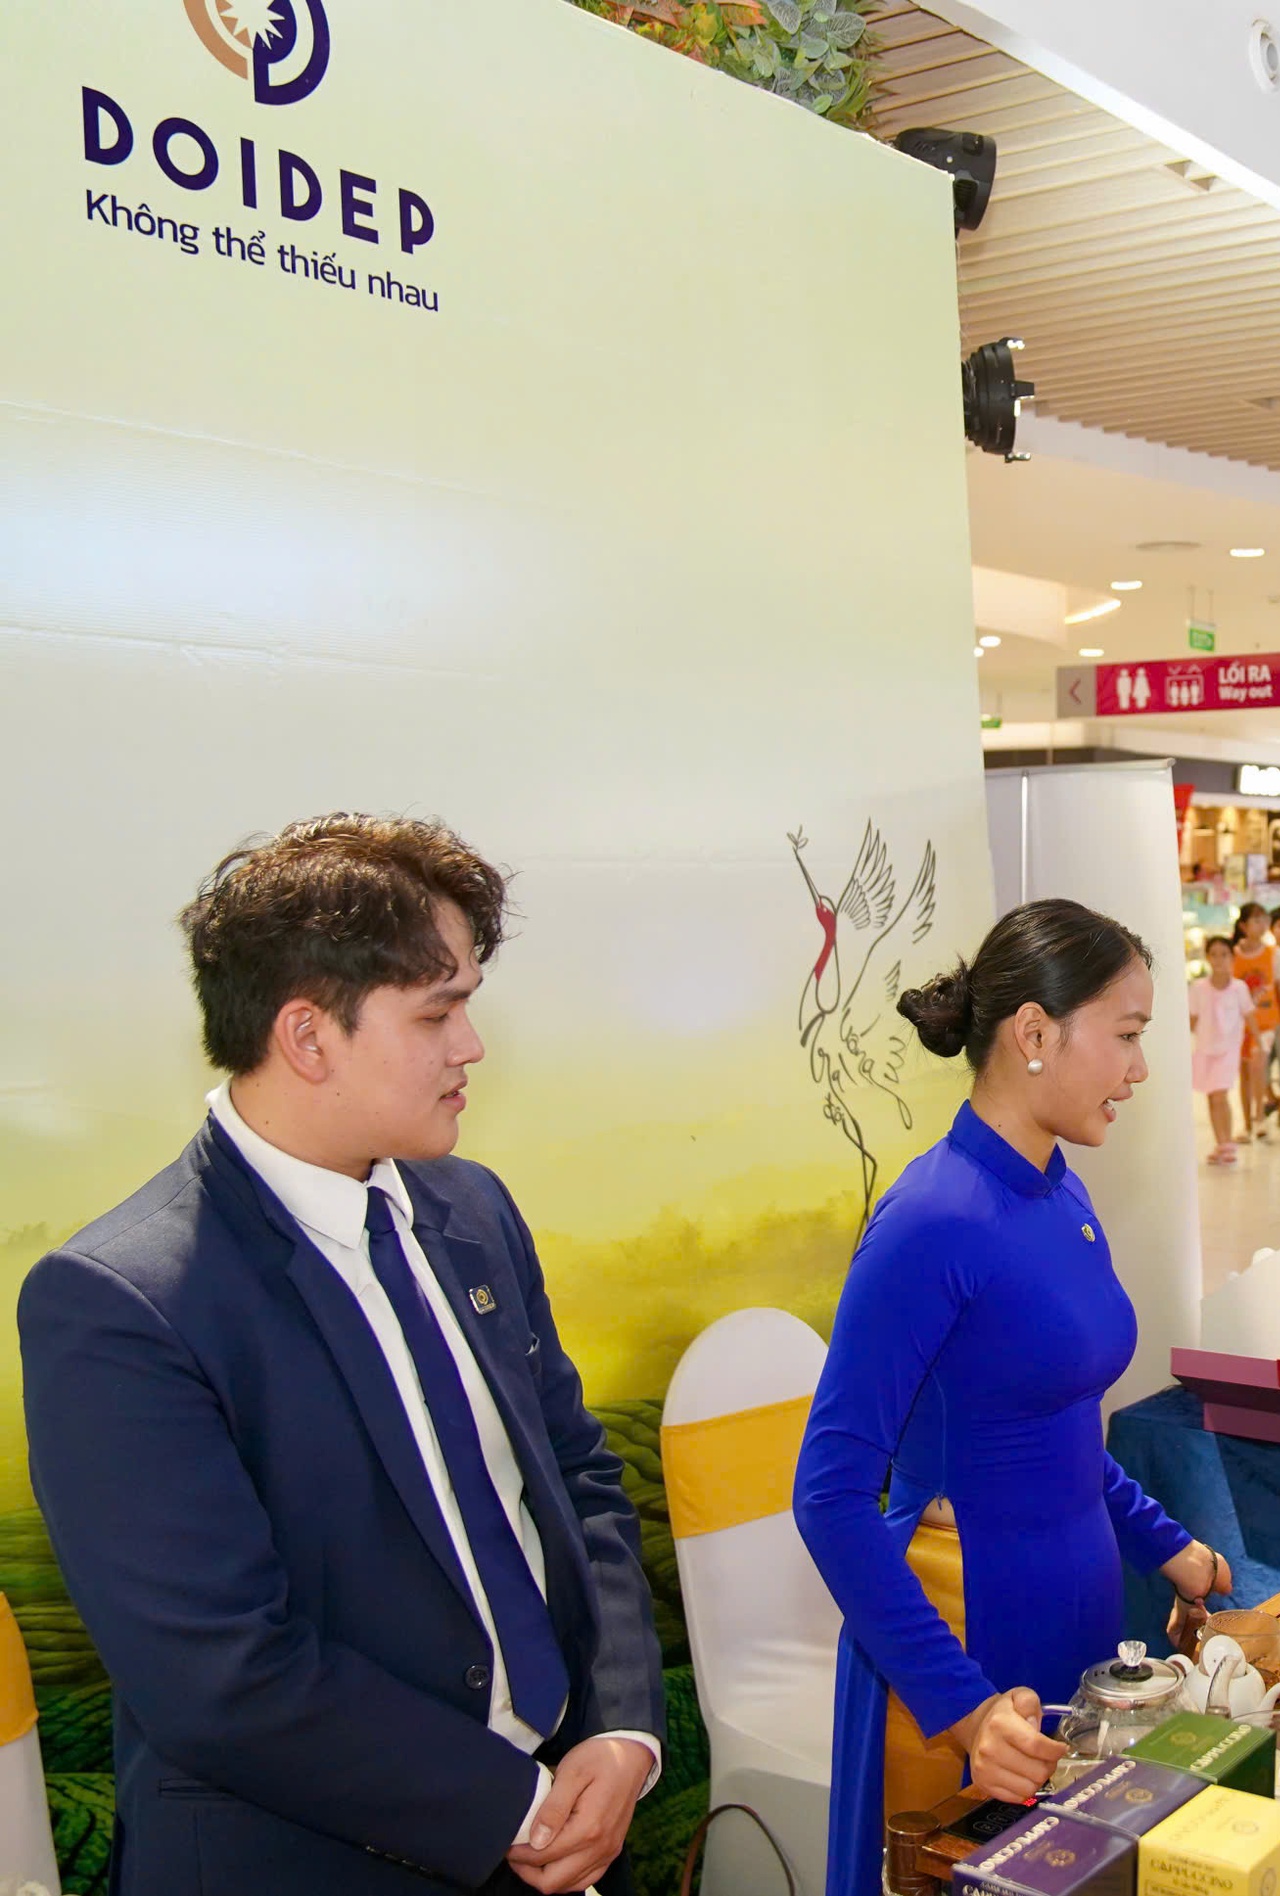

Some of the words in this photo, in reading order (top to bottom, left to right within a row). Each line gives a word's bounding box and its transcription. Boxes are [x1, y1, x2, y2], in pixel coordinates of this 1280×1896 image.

[82, 86, 435, 254] DOIDEP
[85, 189, 200, 255] Không
[212, 226, 266, 265] thể
[278, 244, 356, 290] thiếu
[368, 270, 439, 312] nhau
[1218, 686, 1247, 703] Way
[1249, 684, 1273, 699] out
[1248, 664, 1272, 683] RA
